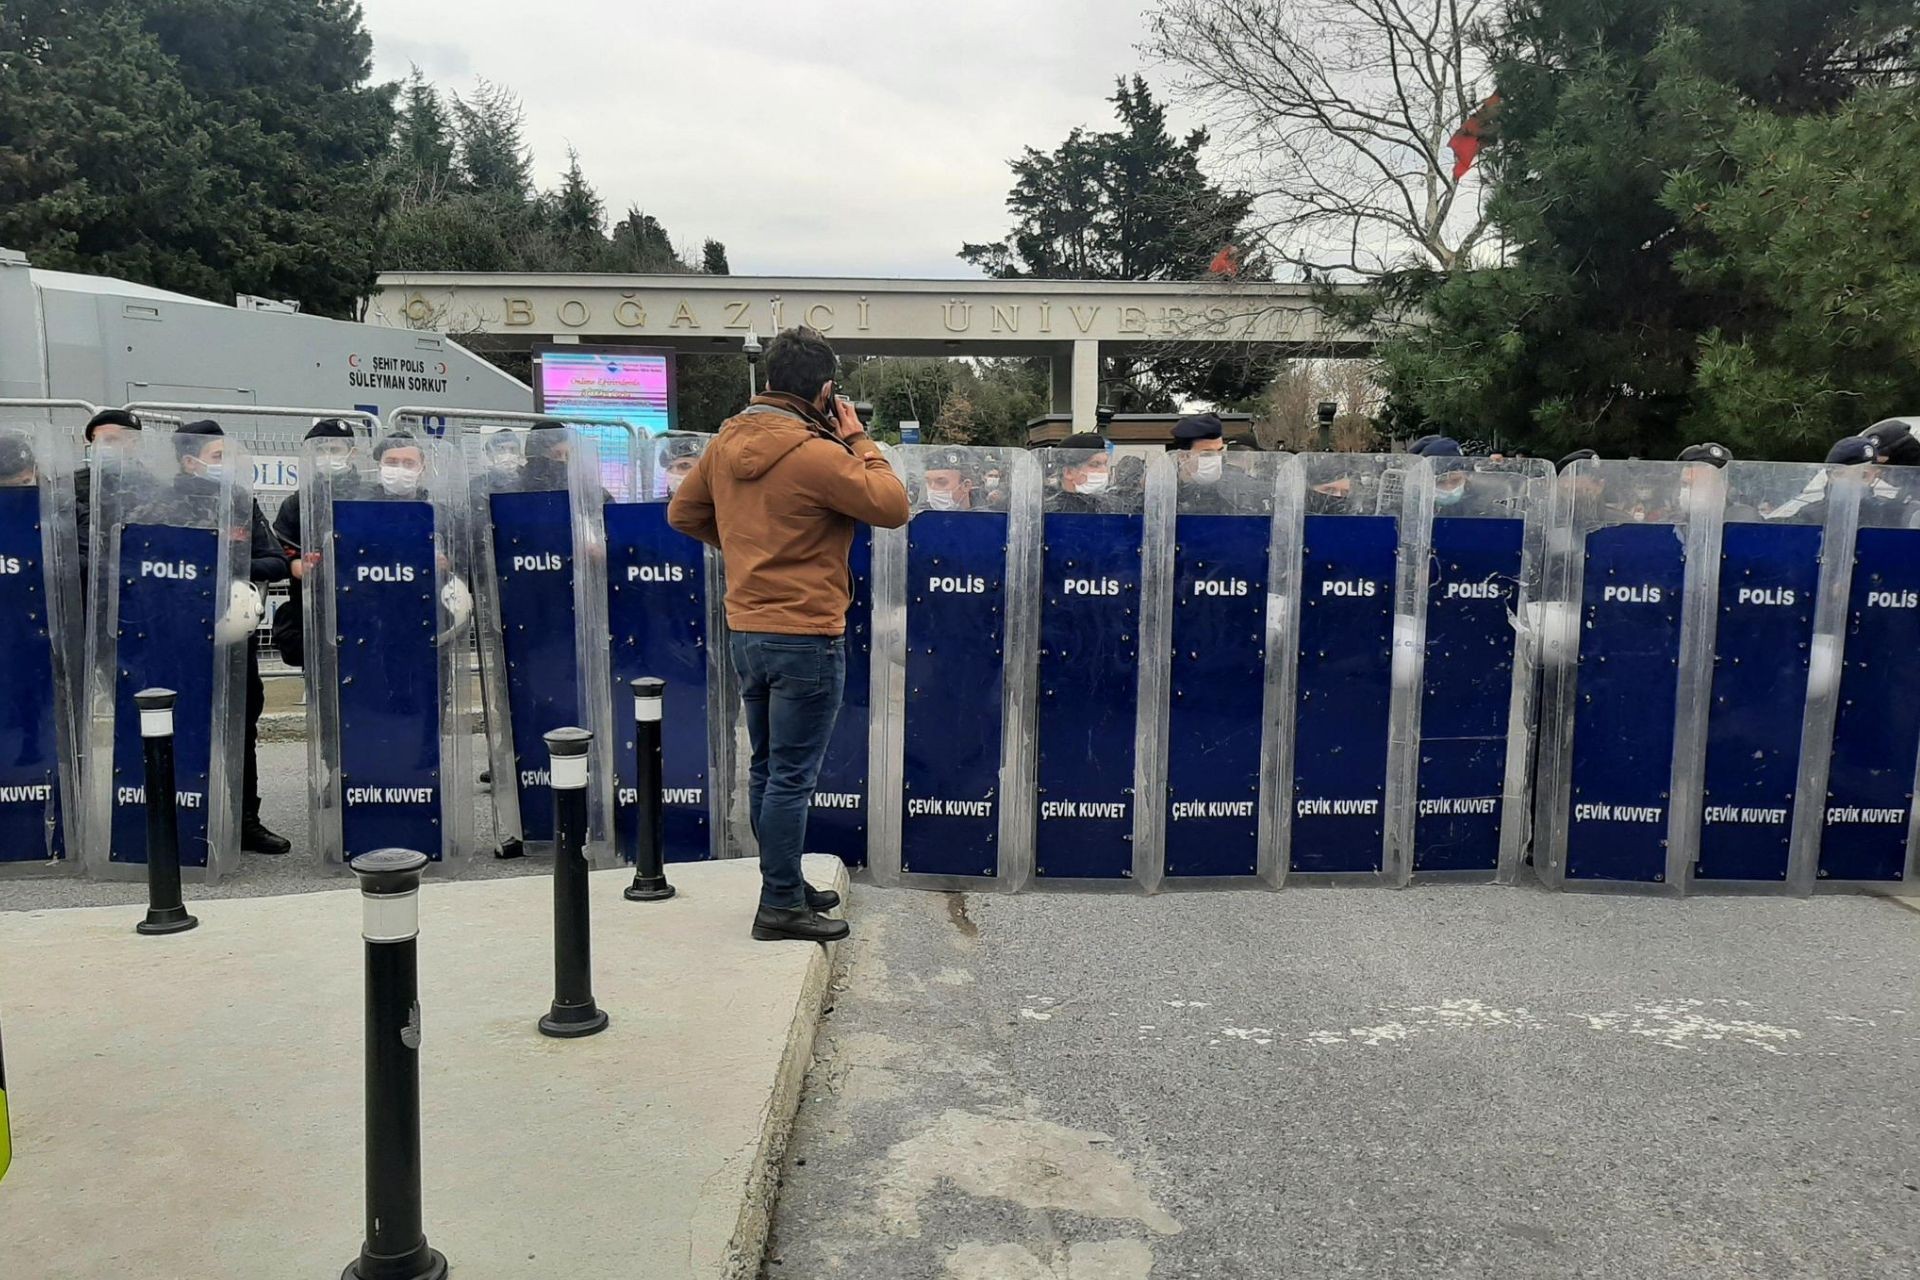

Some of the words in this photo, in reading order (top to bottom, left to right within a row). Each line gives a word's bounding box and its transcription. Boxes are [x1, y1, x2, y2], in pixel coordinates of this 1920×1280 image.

[400, 359, 425, 374] POLİS
[349, 369, 406, 390] SÜLEYMAN
[408, 376, 448, 393] SORKUT
[514, 552, 561, 570] POLİS
[142, 561, 197, 580] POLİS
[358, 563, 414, 581] POLİS
[628, 563, 682, 581] POLİS
[930, 575, 984, 593] POLİS
[1064, 577, 1119, 595] POLİS
[1195, 578, 1247, 595] POLİS
[1323, 578, 1375, 596] POLİS
[1605, 584, 1660, 602] POLİS
[1739, 587, 1794, 605] POLİS
[1868, 590, 1917, 607] POLİS
[0, 785, 51, 802] KUVVET
[118, 786, 146, 806] ÇEVİ
[347, 785, 382, 807] ÇEVİK
[385, 787, 432, 803] KUVVET
[814, 792, 861, 809] KUVVET
[908, 797, 942, 817] ÇEVİK
[945, 799, 991, 817] KUVVET
[1042, 799, 1077, 820] ÇEVİK
[1079, 802, 1125, 819] KUVVET
[1172, 799, 1206, 821] ÇEVİK
[1208, 802, 1253, 817] KUVVET
[1298, 797, 1332, 818] ÇEVİK
[1335, 799, 1379, 815] KUVVET
[1420, 797, 1451, 818] ÇEVİK
[1454, 799, 1496, 814] KUVVET
[1575, 802, 1610, 823] ÇEVİK
[1613, 806, 1661, 823] KUVVET
[1704, 805, 1739, 825] ÇEVİK
[1741, 808, 1786, 824] KUVVET
[1826, 805, 1859, 826] ÇEVİK
[1861, 808, 1905, 823] KUVVET
